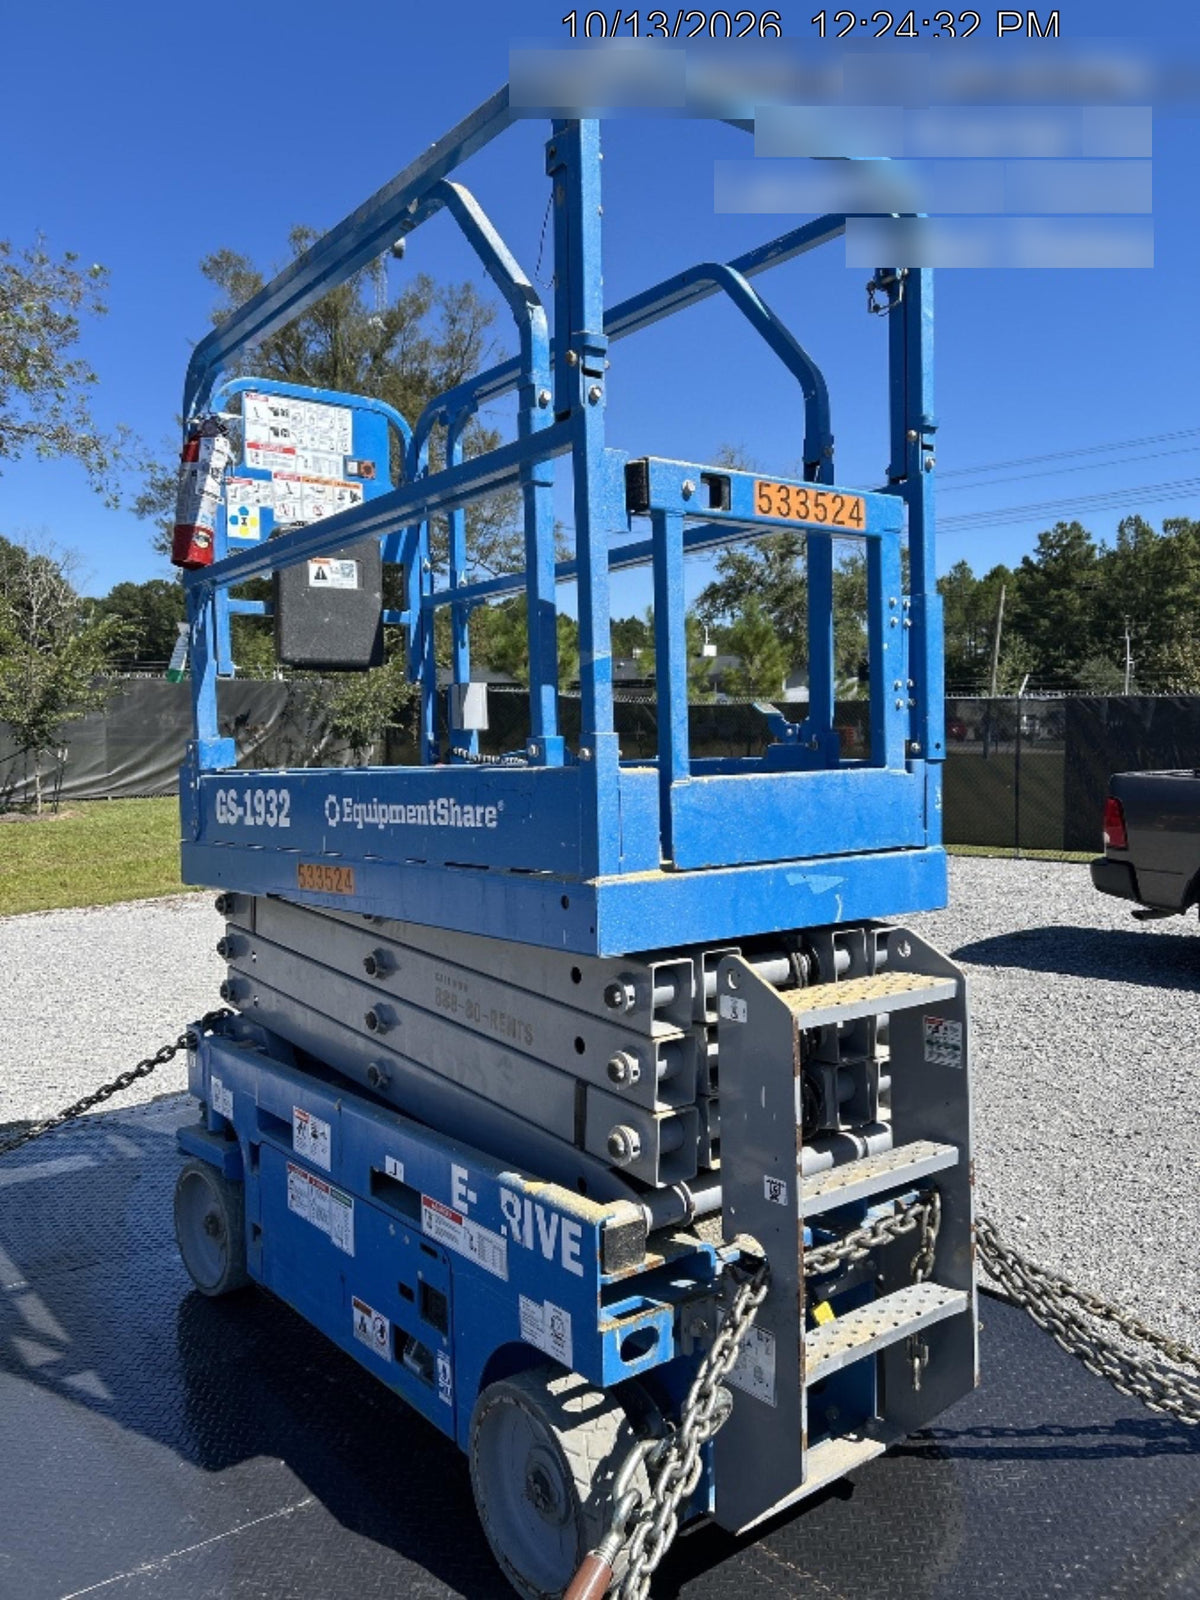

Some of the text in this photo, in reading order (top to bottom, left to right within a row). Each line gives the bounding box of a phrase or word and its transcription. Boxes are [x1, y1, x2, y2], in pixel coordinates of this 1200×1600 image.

[758, 481, 862, 528] 533524
[215, 788, 291, 828] GS-1932
[298, 864, 353, 893] 533524
